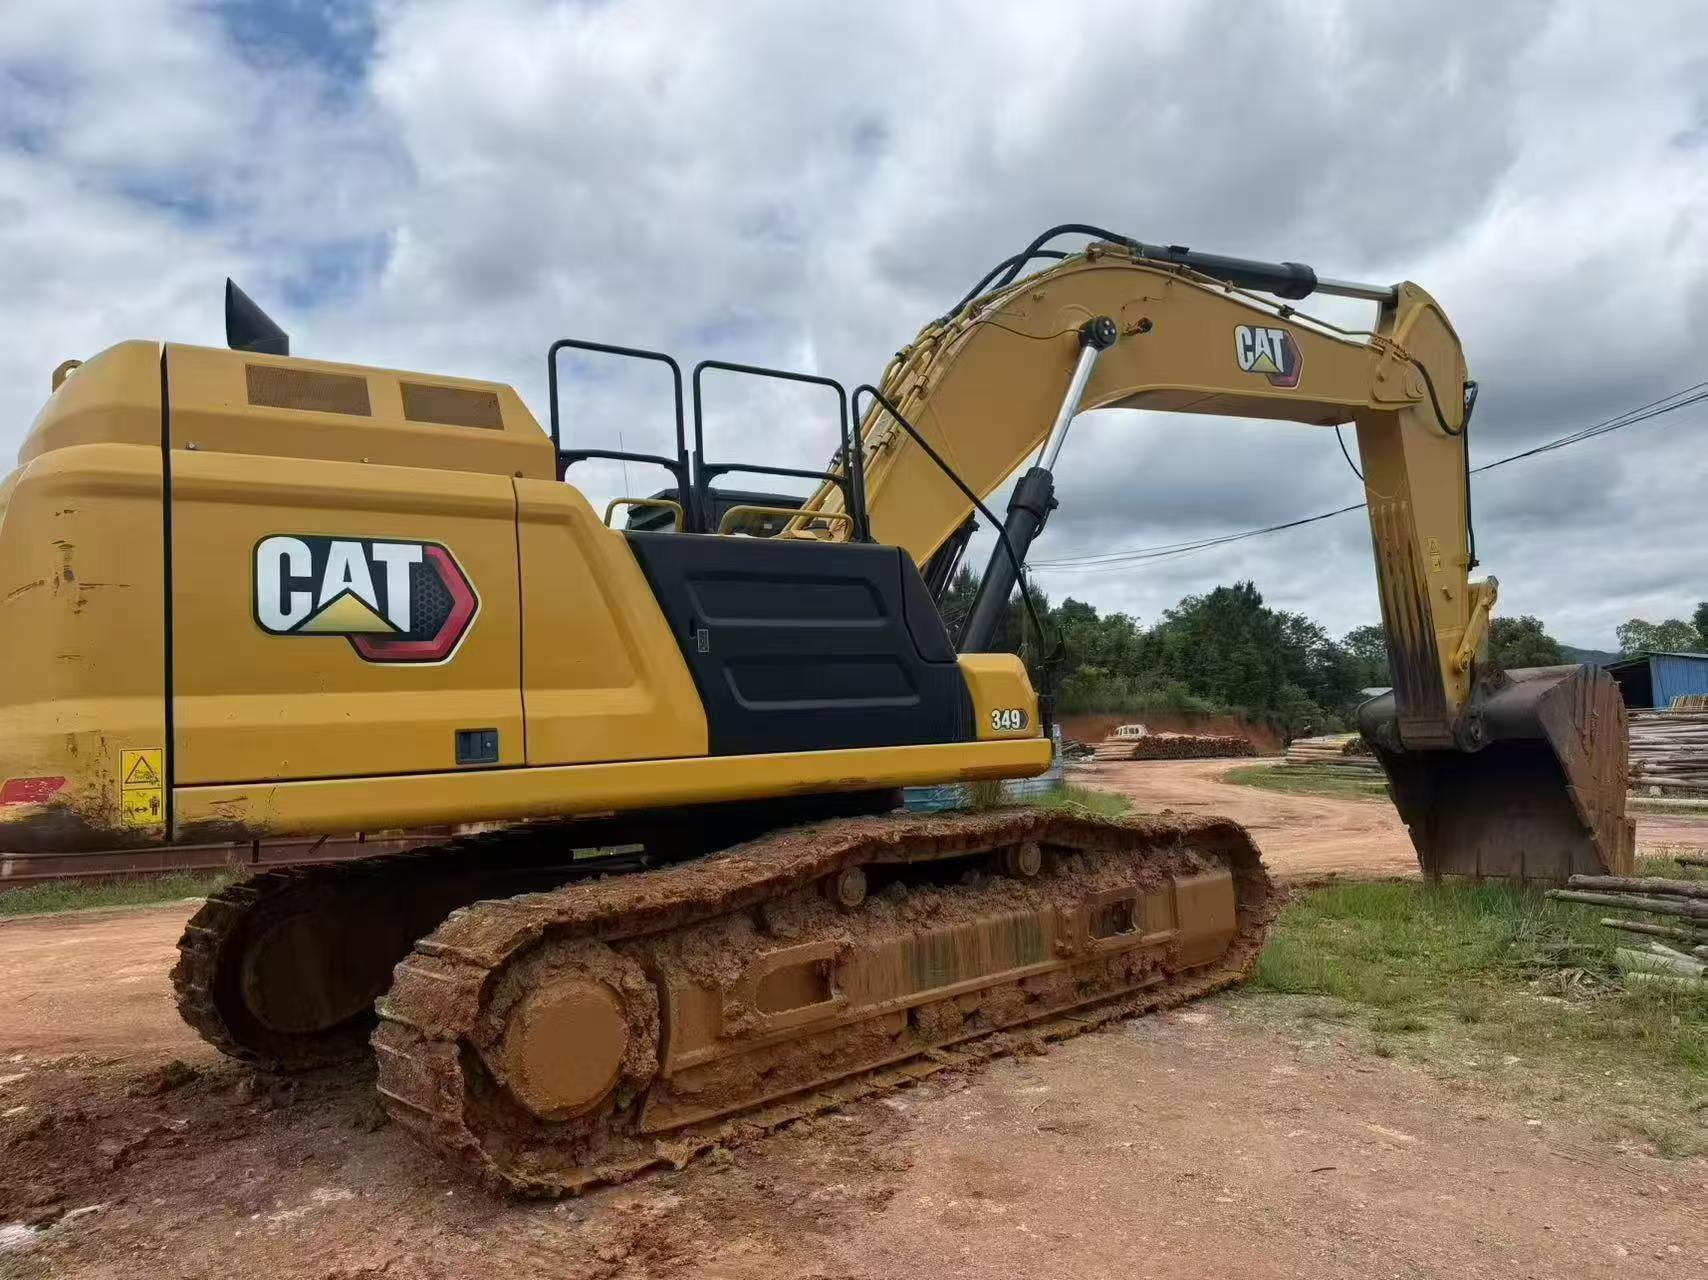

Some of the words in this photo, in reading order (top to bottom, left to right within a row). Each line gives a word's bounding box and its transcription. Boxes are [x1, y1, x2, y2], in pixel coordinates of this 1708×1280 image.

[1235, 325, 1284, 373] CAT
[257, 536, 423, 633] CAT
[991, 709, 1021, 730] 349
